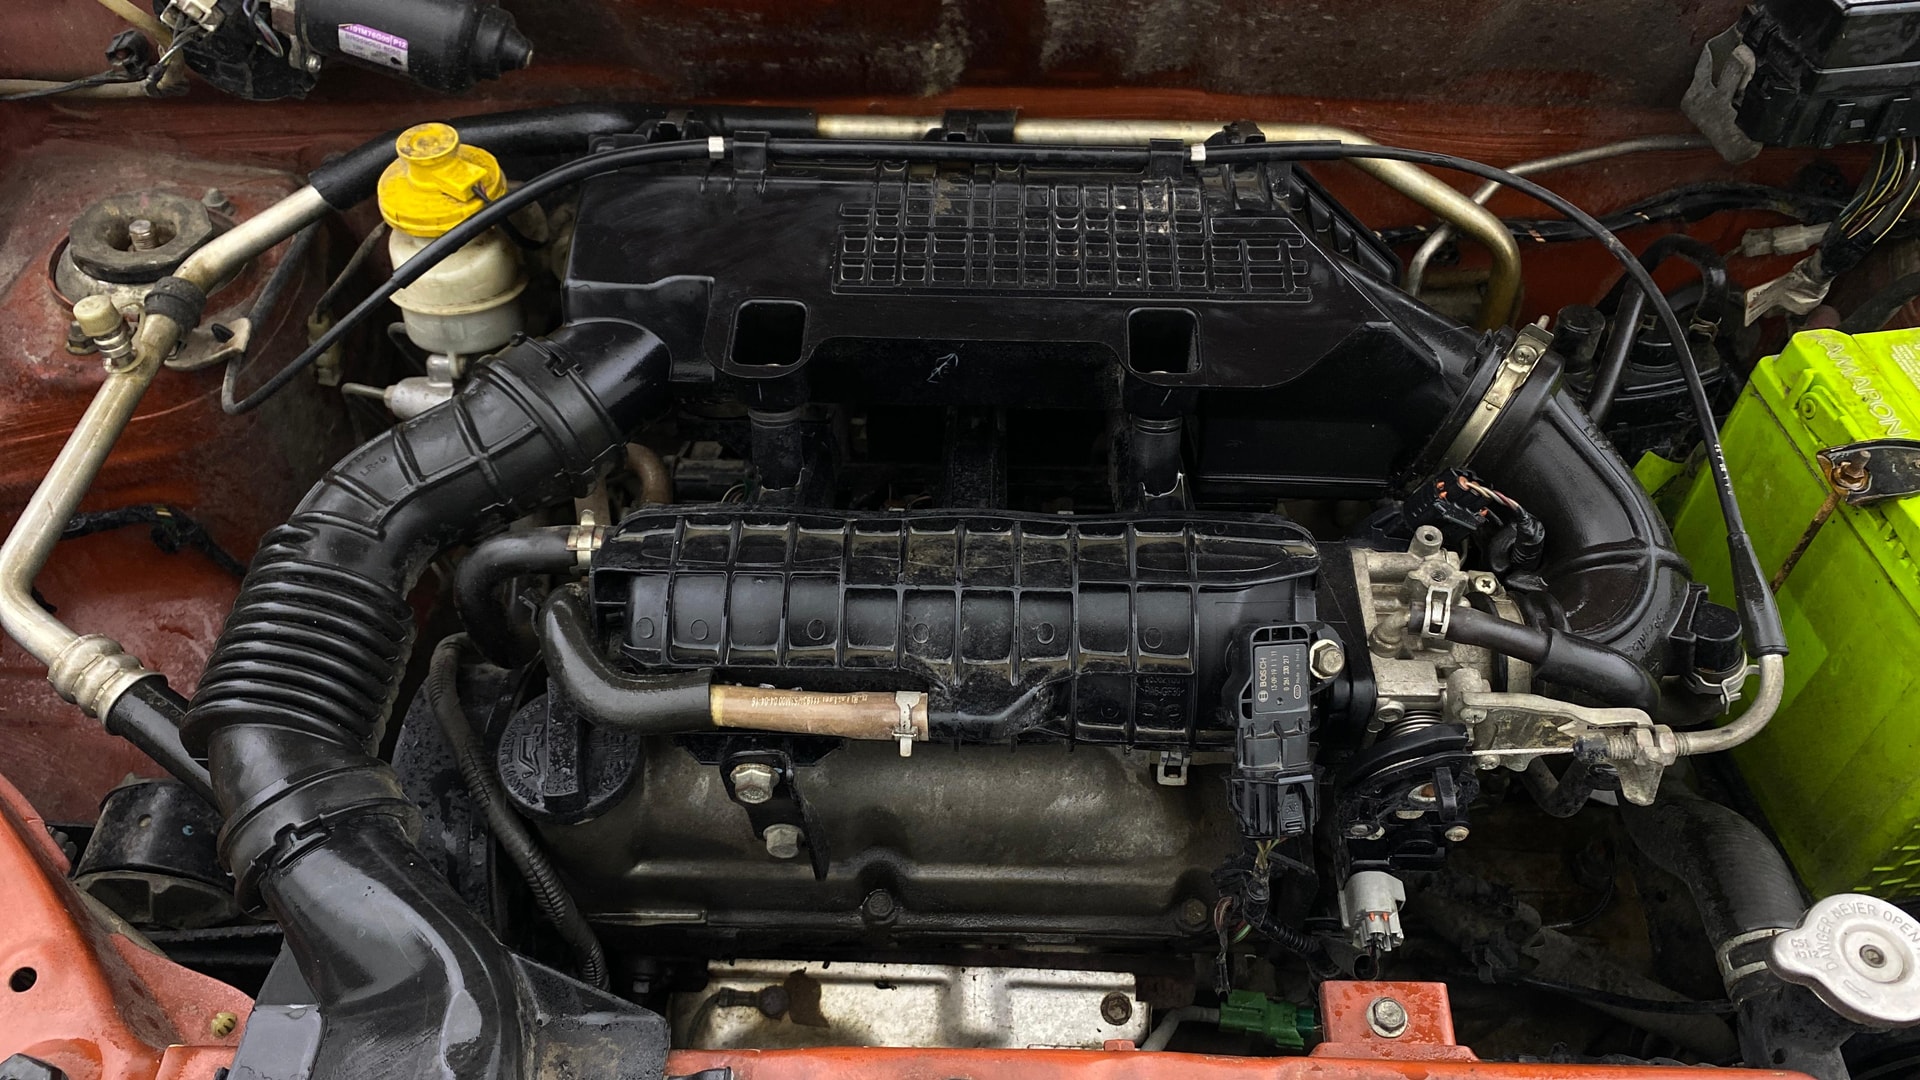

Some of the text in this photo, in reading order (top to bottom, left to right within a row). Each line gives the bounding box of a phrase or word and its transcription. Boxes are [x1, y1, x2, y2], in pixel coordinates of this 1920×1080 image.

[1259, 657, 1267, 688] BOSCH
[1816, 902, 1920, 971] DANGER NEVER OPEN
